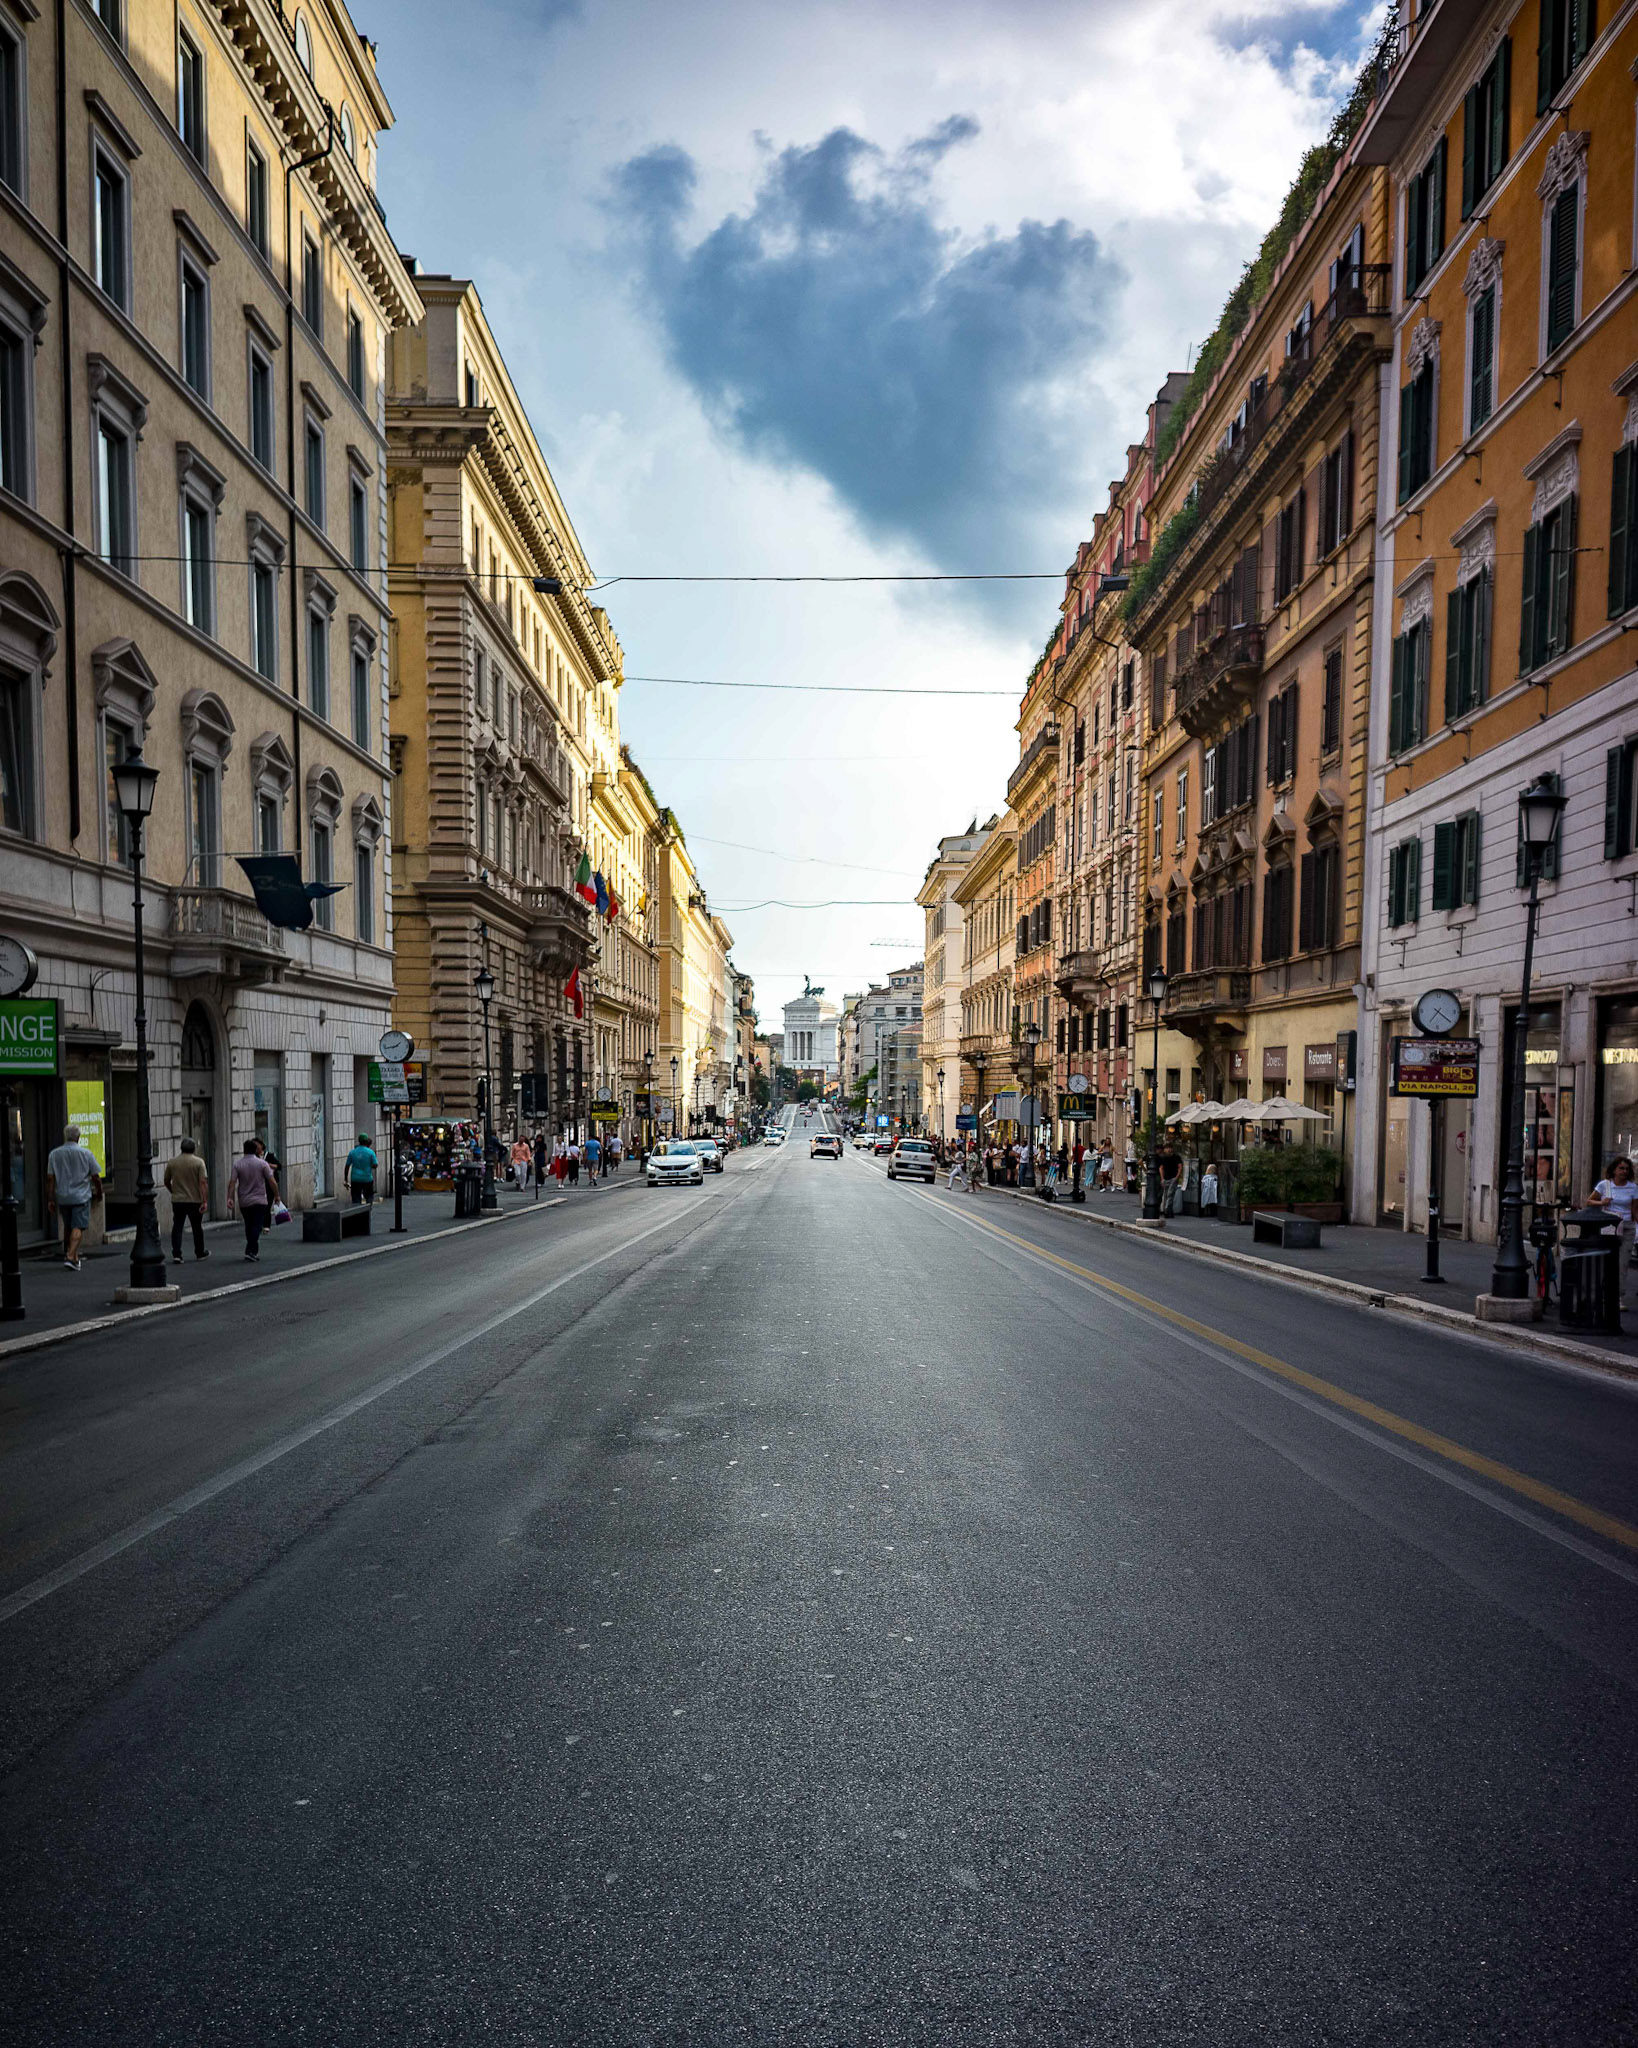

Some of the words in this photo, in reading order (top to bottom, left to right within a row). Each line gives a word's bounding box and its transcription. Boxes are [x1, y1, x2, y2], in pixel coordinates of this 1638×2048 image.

[1, 1015, 54, 1042] NGE
[0, 1047, 53, 1057] MISSION
[1308, 1049, 1333, 1065] Ristorante
[1420, 1083, 1460, 1091] NAPOLI,
